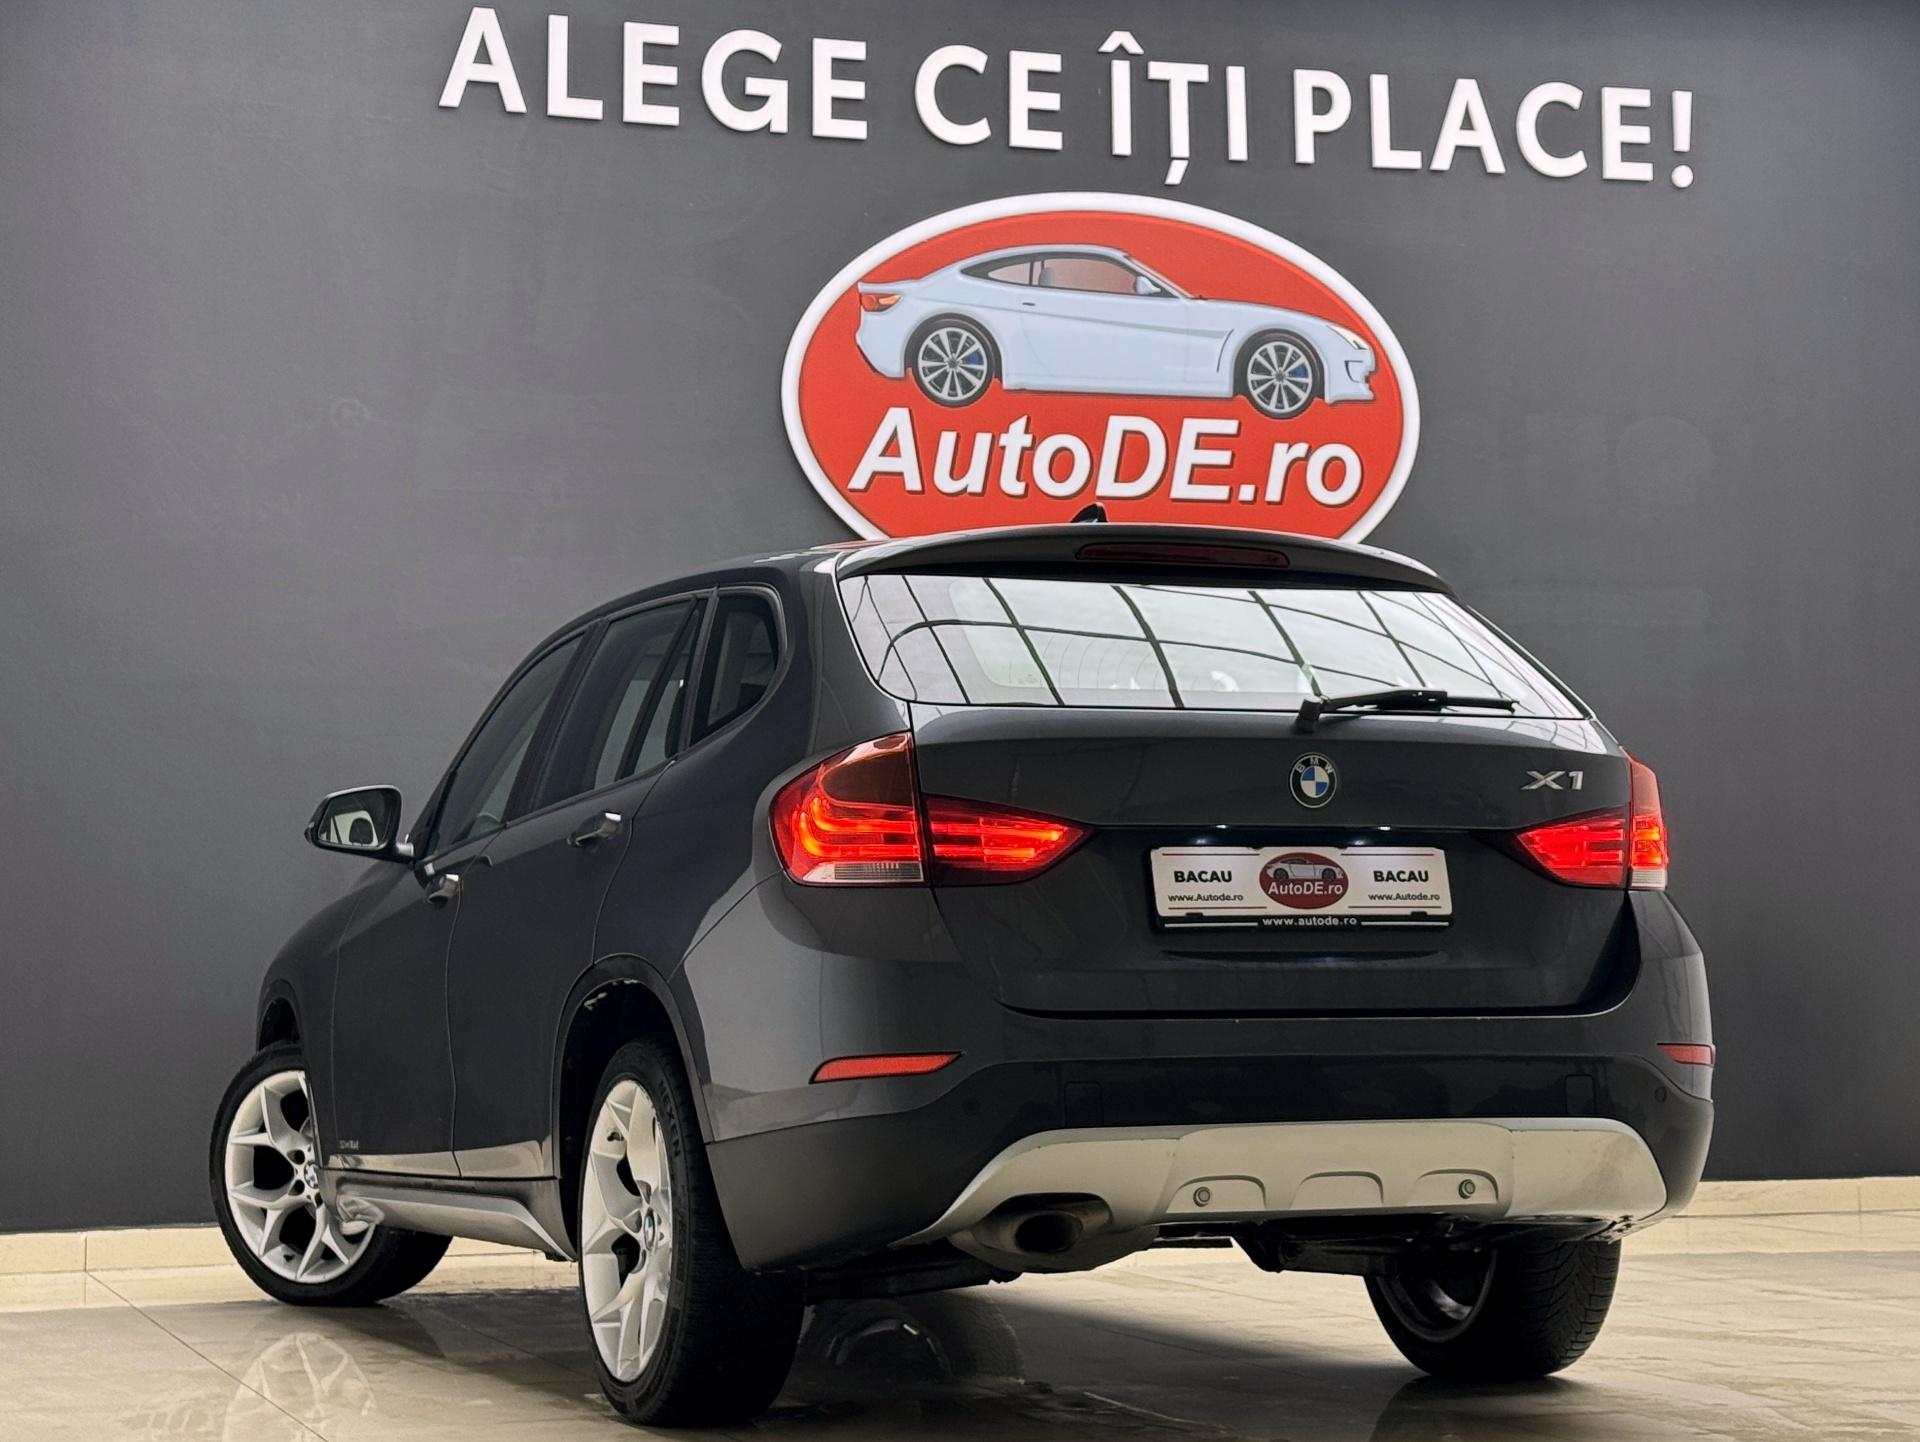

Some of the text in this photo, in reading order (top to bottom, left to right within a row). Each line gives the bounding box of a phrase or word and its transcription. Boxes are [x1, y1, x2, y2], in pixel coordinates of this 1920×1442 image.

[438, 6, 1695, 189] ALEGE CE ÎȚI PLACE!
[847, 406, 1363, 507] AutoDE.ro
[1295, 756, 1335, 774] BMW
[1520, 770, 1584, 790] X1
[1173, 869, 1233, 883] BACAU
[1373, 869, 1430, 883] BACAU
[1267, 881, 1344, 895] AutoDE.ro
[1167, 892, 1244, 902] www.Autode.ro
[1367, 891, 1441, 901] www.Autode.ro
[1262, 915, 1358, 926] www.autode.ro
[657, 1079, 682, 1158] NEXEN
